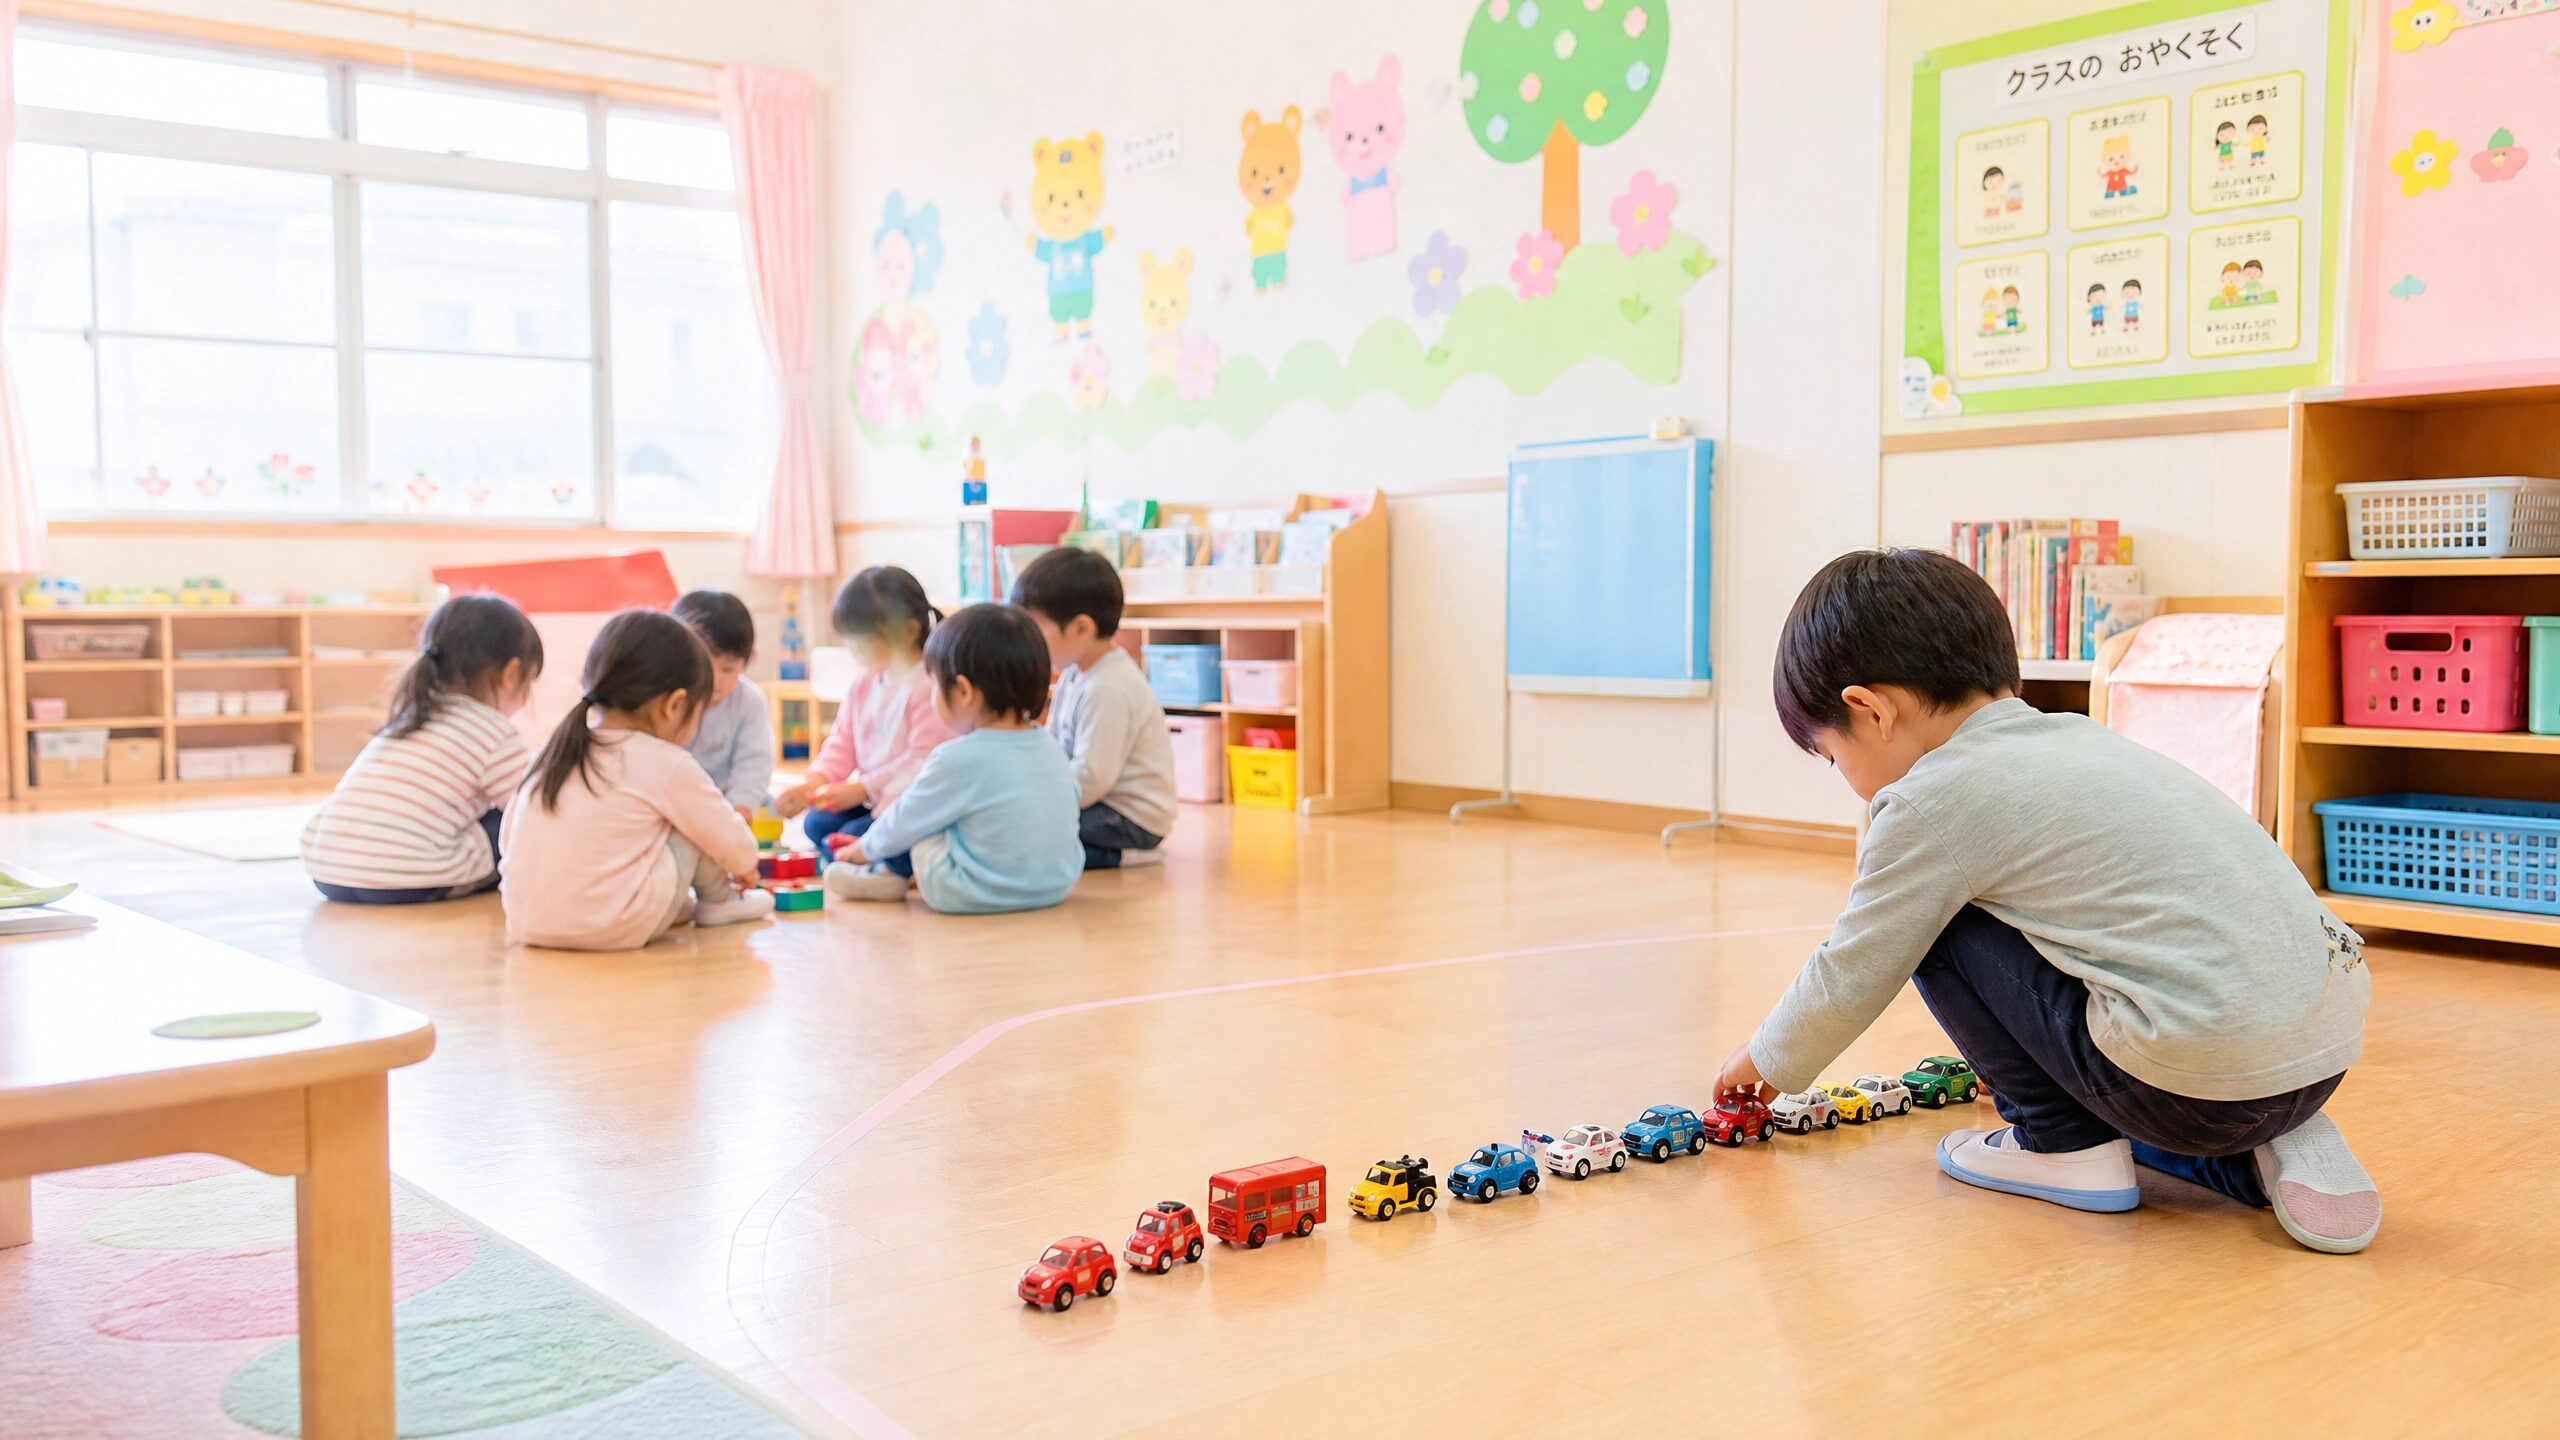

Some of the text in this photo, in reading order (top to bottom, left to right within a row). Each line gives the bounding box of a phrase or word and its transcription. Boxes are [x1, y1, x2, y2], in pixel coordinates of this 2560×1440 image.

[2007, 22, 2243, 96] クラスの おやくそく
